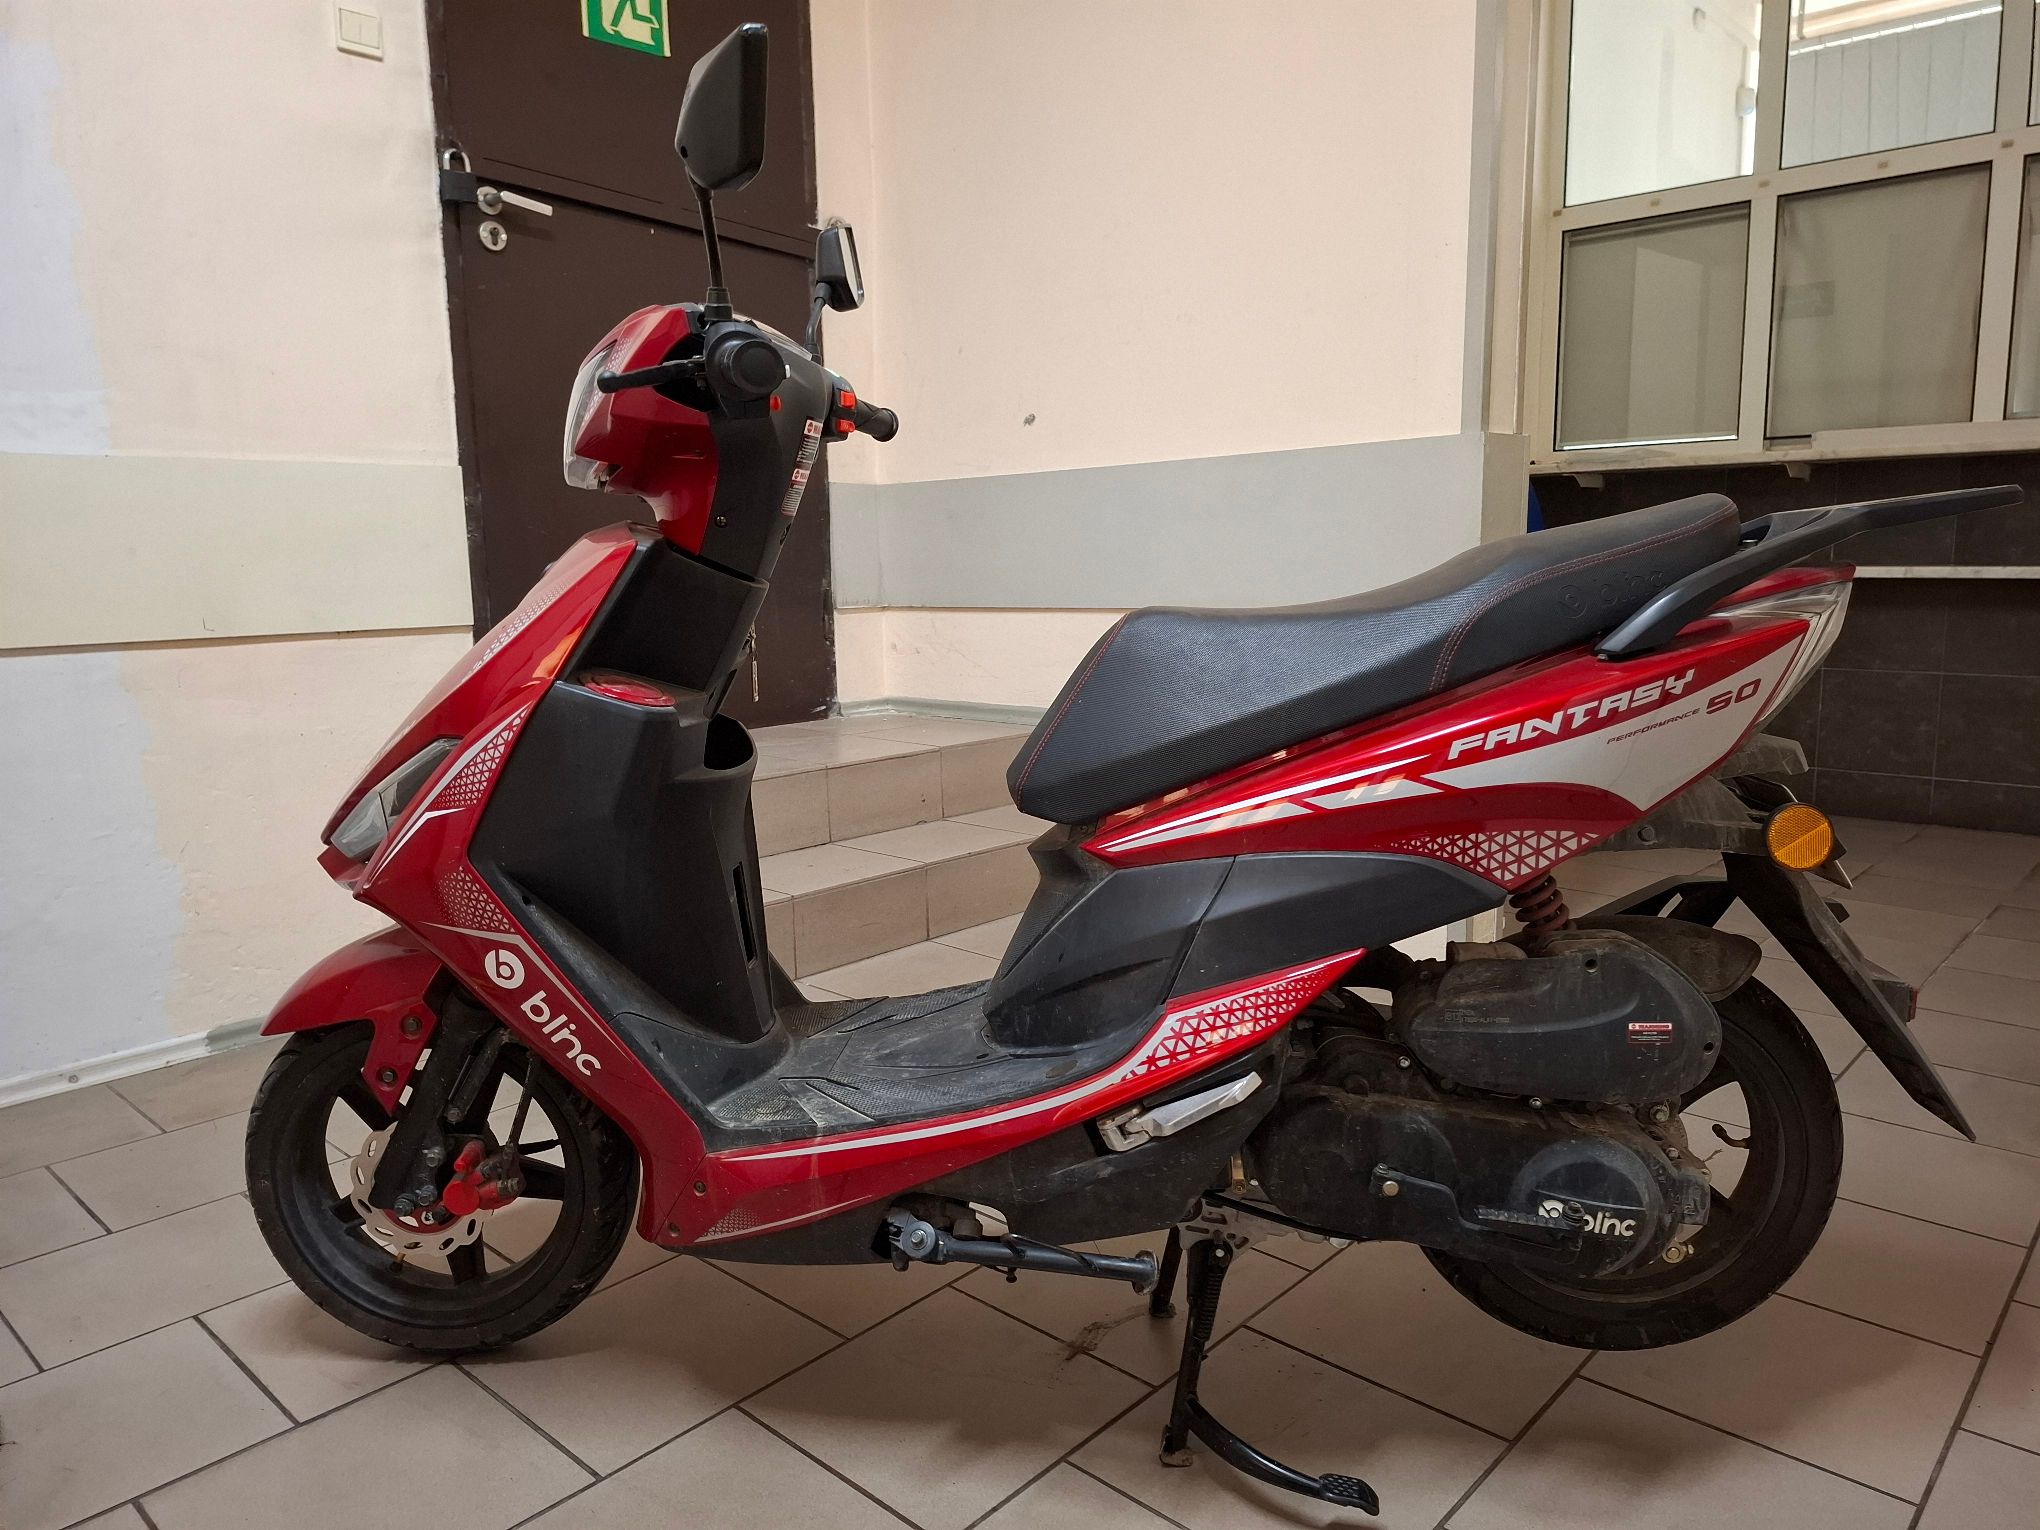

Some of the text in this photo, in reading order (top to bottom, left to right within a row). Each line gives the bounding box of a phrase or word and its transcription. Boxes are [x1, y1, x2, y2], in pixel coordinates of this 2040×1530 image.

[1447, 667, 1696, 761] FANTASY
[1606, 677, 1763, 745] PERFORMANCE 50
[519, 989, 602, 1077] blinc
